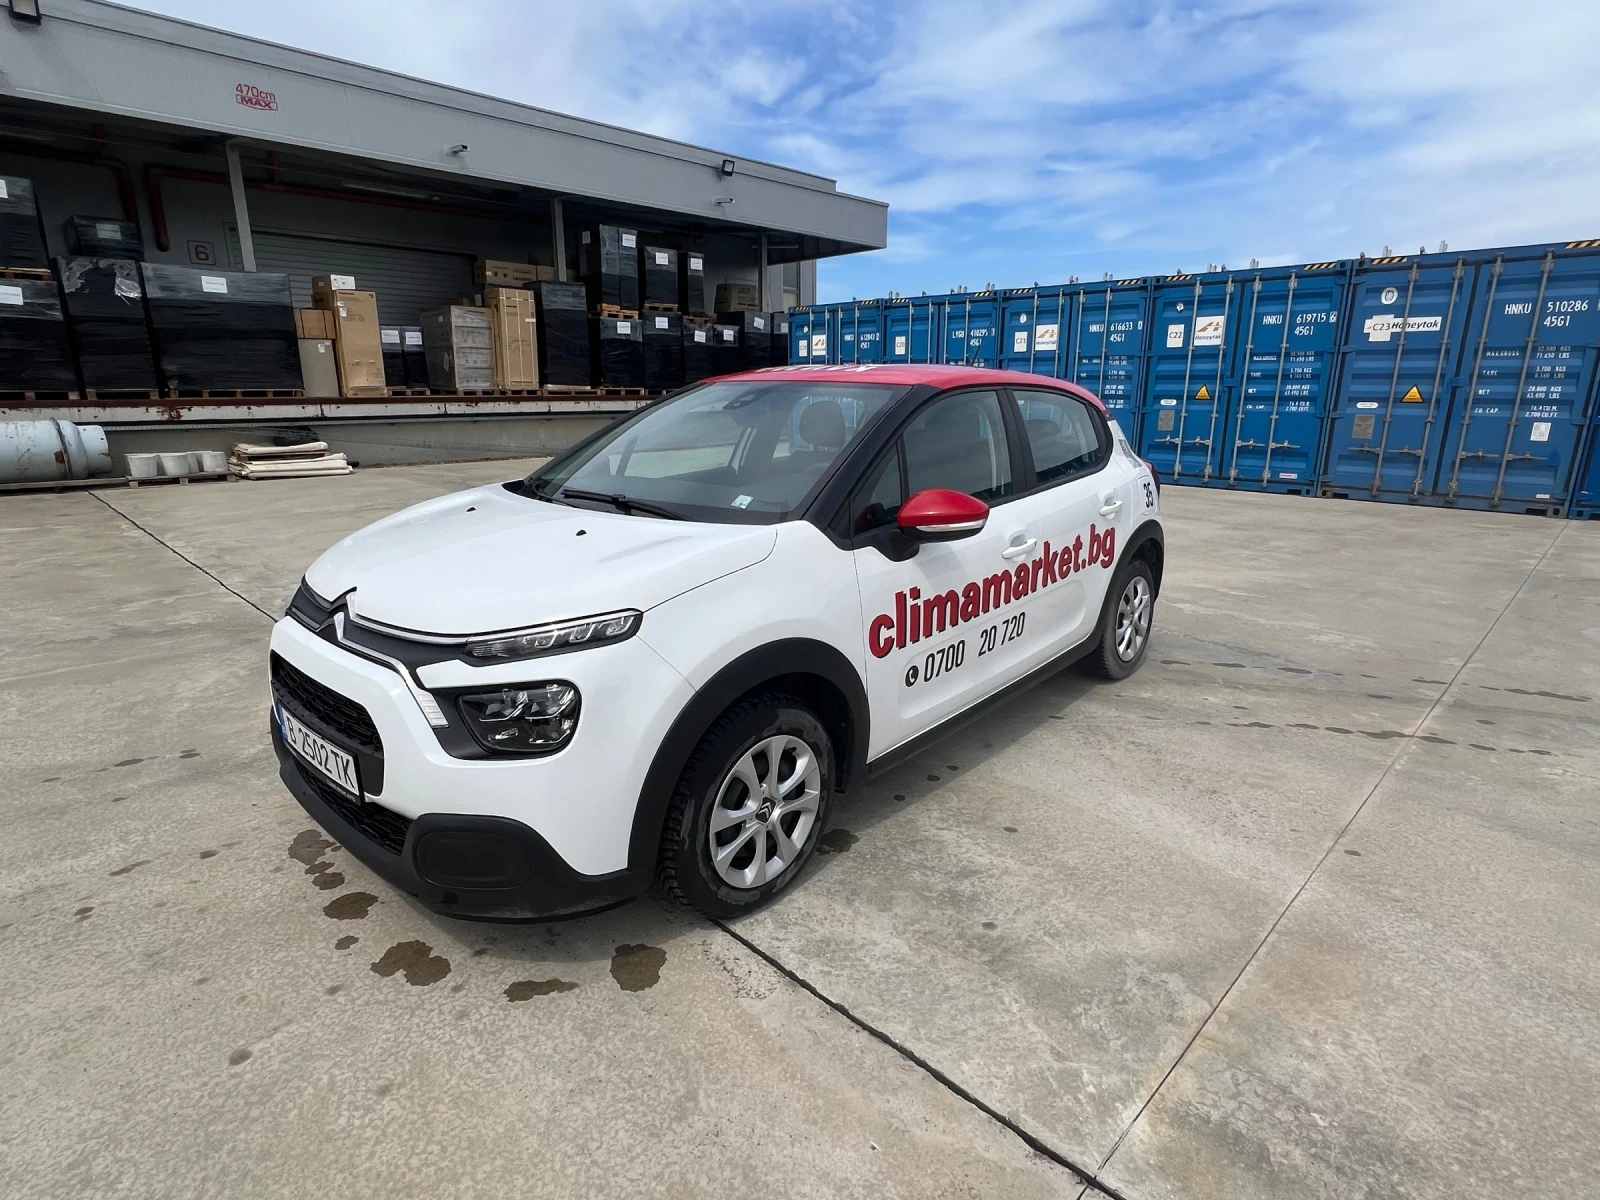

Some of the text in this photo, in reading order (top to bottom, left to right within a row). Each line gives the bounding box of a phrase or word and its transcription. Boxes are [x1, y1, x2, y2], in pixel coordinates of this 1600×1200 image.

[235, 83, 276, 102] 470cm
[240, 95, 273, 109] MAX
[195, 244, 210, 261] 6
[1504, 303, 1532, 315] HNKU
[1546, 299, 1589, 313] 510286
[1262, 310, 1338, 325] HNKU 619715 6
[1543, 315, 1571, 327] 45G1
[1110, 321, 1133, 331] 616633
[1294, 326, 1314, 336] 45G1
[1372, 322, 1391, 331] C23
[1109, 333, 1125, 343] 45G1
[1168, 331, 1183, 339] C22
[1143, 482, 1154, 508] 35
[868, 523, 1116, 659] climamarket.bg
[923, 611, 1026, 683] 0700 20 720
[286, 716, 356, 790] B 2502 TK
